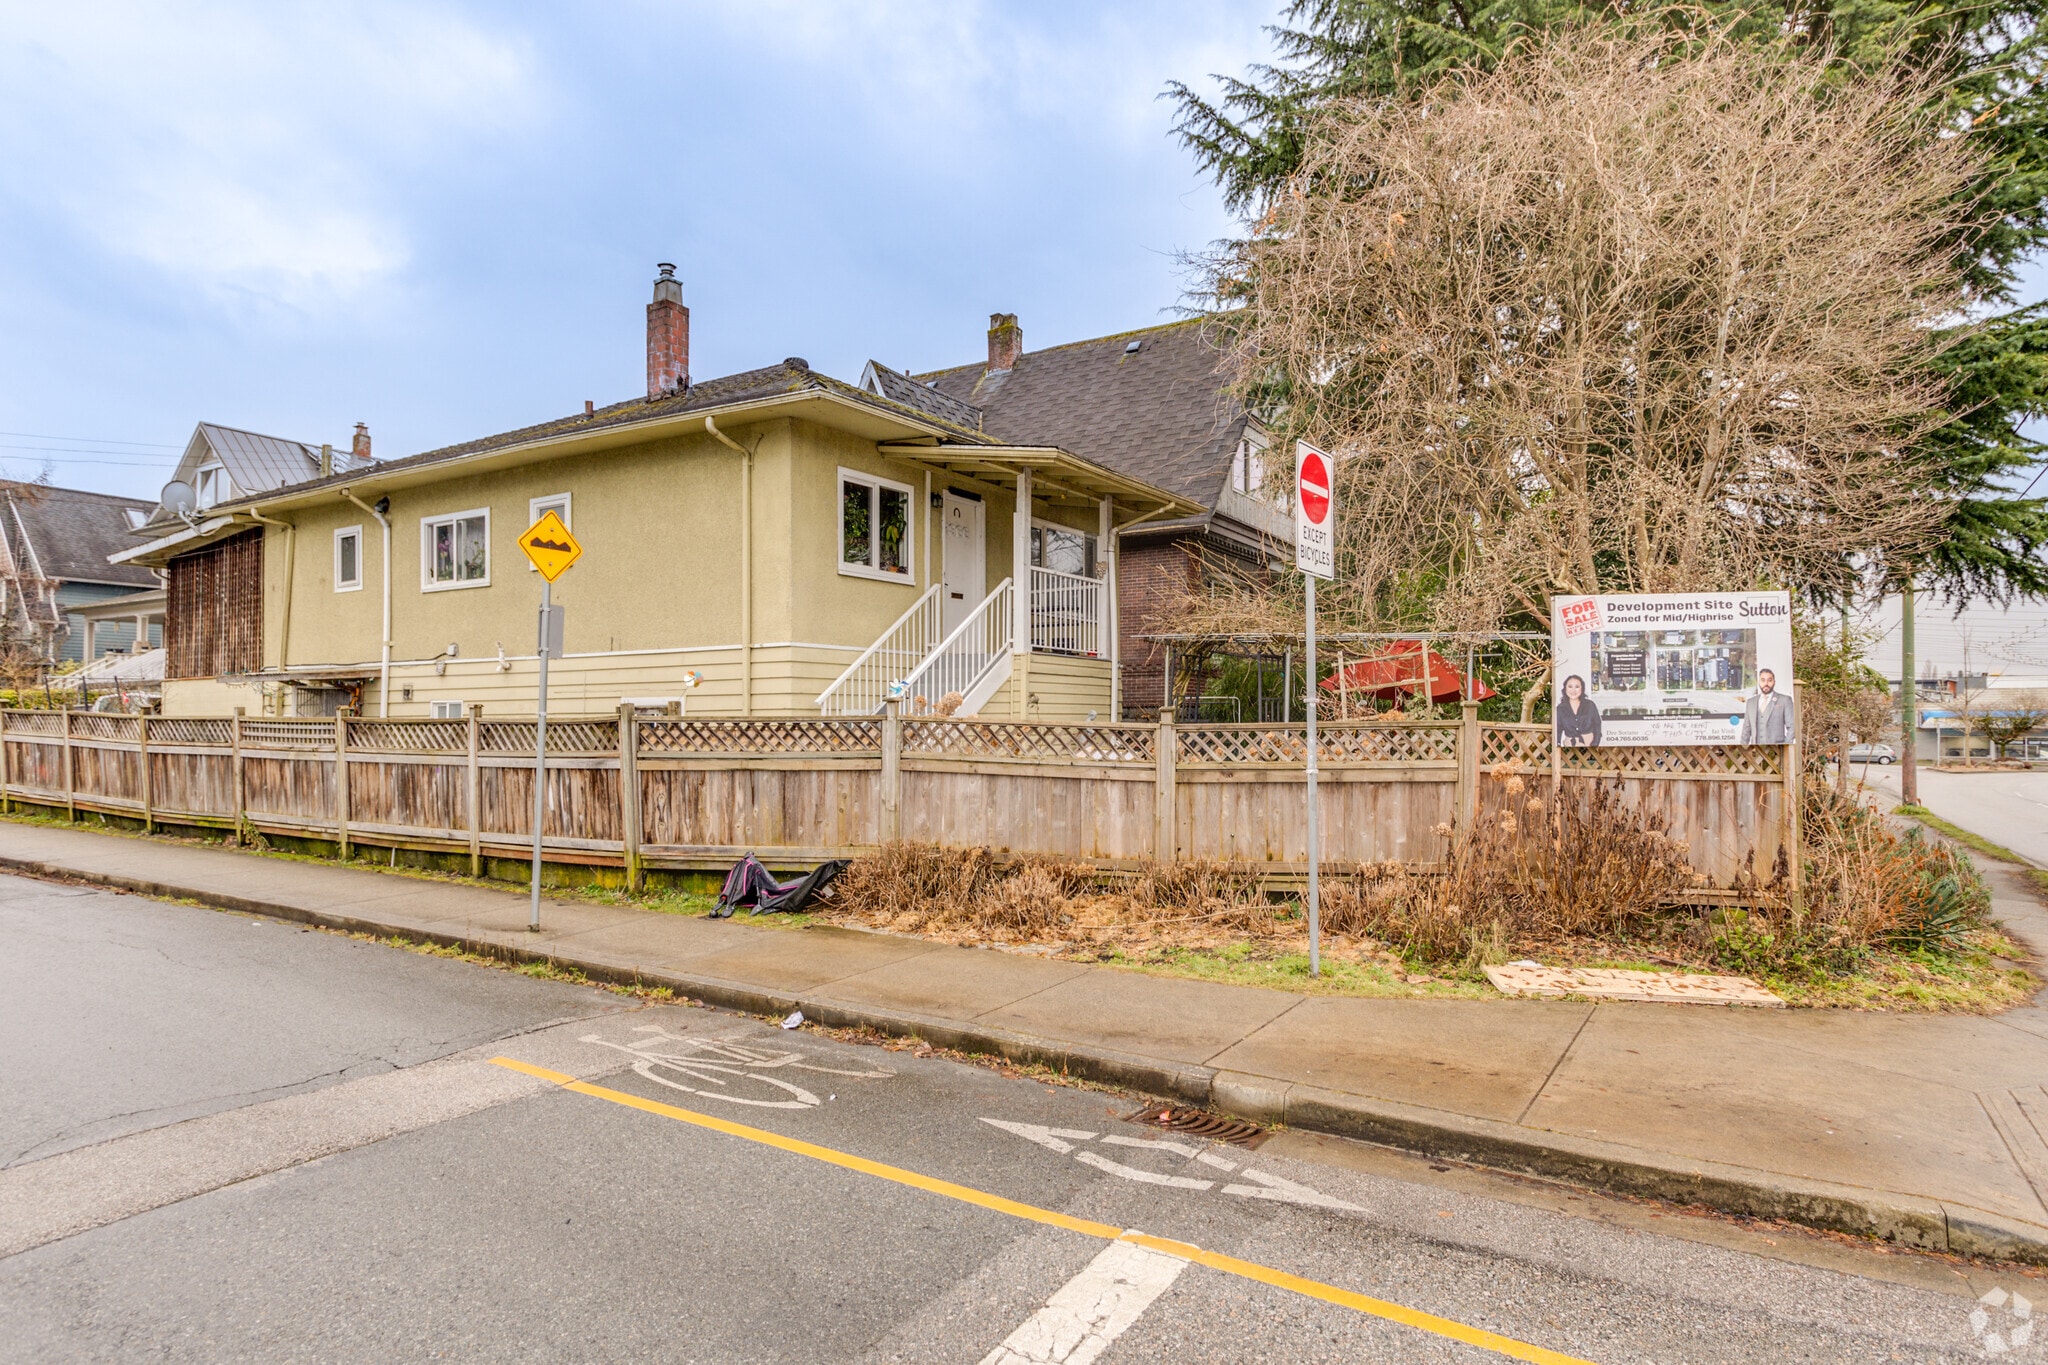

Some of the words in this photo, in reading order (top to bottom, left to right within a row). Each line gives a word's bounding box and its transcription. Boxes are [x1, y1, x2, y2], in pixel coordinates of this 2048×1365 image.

[1303, 525, 1327, 545] EXCEPT
[1300, 544, 1330, 566] BICYCLES
[1561, 600, 1595, 618] FOR
[1607, 602, 1700, 612] Development
[1704, 600, 1733, 609] Site
[1739, 601, 1788, 617] Sutton
[1565, 611, 1599, 627] SALE
[1607, 615, 1641, 623] Zoned
[1644, 614, 1660, 622] for
[1662, 613, 1734, 623] Mid/Highrise
